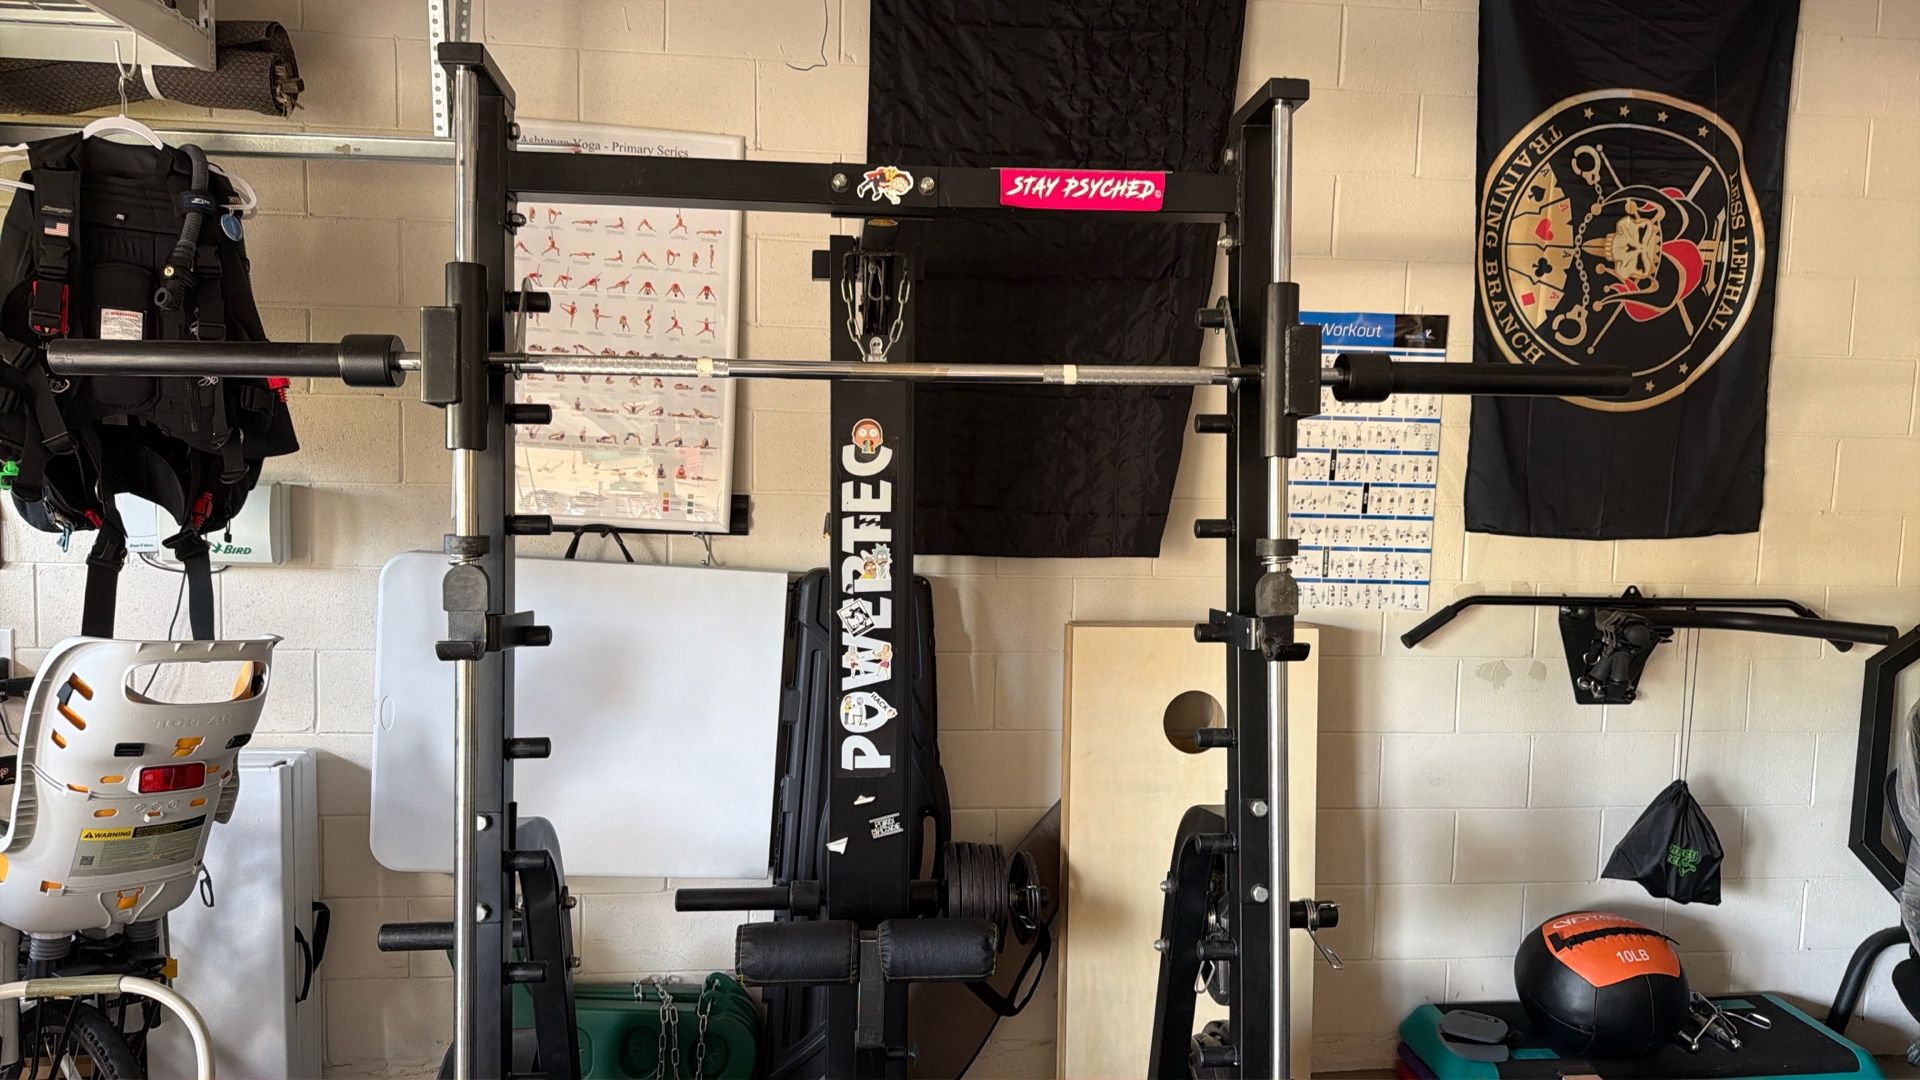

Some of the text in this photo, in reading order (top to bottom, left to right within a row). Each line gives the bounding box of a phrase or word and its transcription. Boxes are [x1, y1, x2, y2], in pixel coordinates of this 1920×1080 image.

[573, 138, 601, 152] Yoga
[612, 141, 654, 155] Primary
[657, 145, 689, 158] Series
[1006, 175, 1156, 201] STAY PSYCHED
[1484, 124, 1565, 364] TRAINING BRANCH
[1708, 170, 1750, 332] LESS LETHAL
[1322, 322, 1383, 338] Workout
[223, 544, 252, 555] BIRD
[840, 444, 893, 771] POWERTEC
[870, 693, 888, 711] HACK
[94, 830, 132, 839] WARNING
[1616, 949, 1650, 963] 10LB
